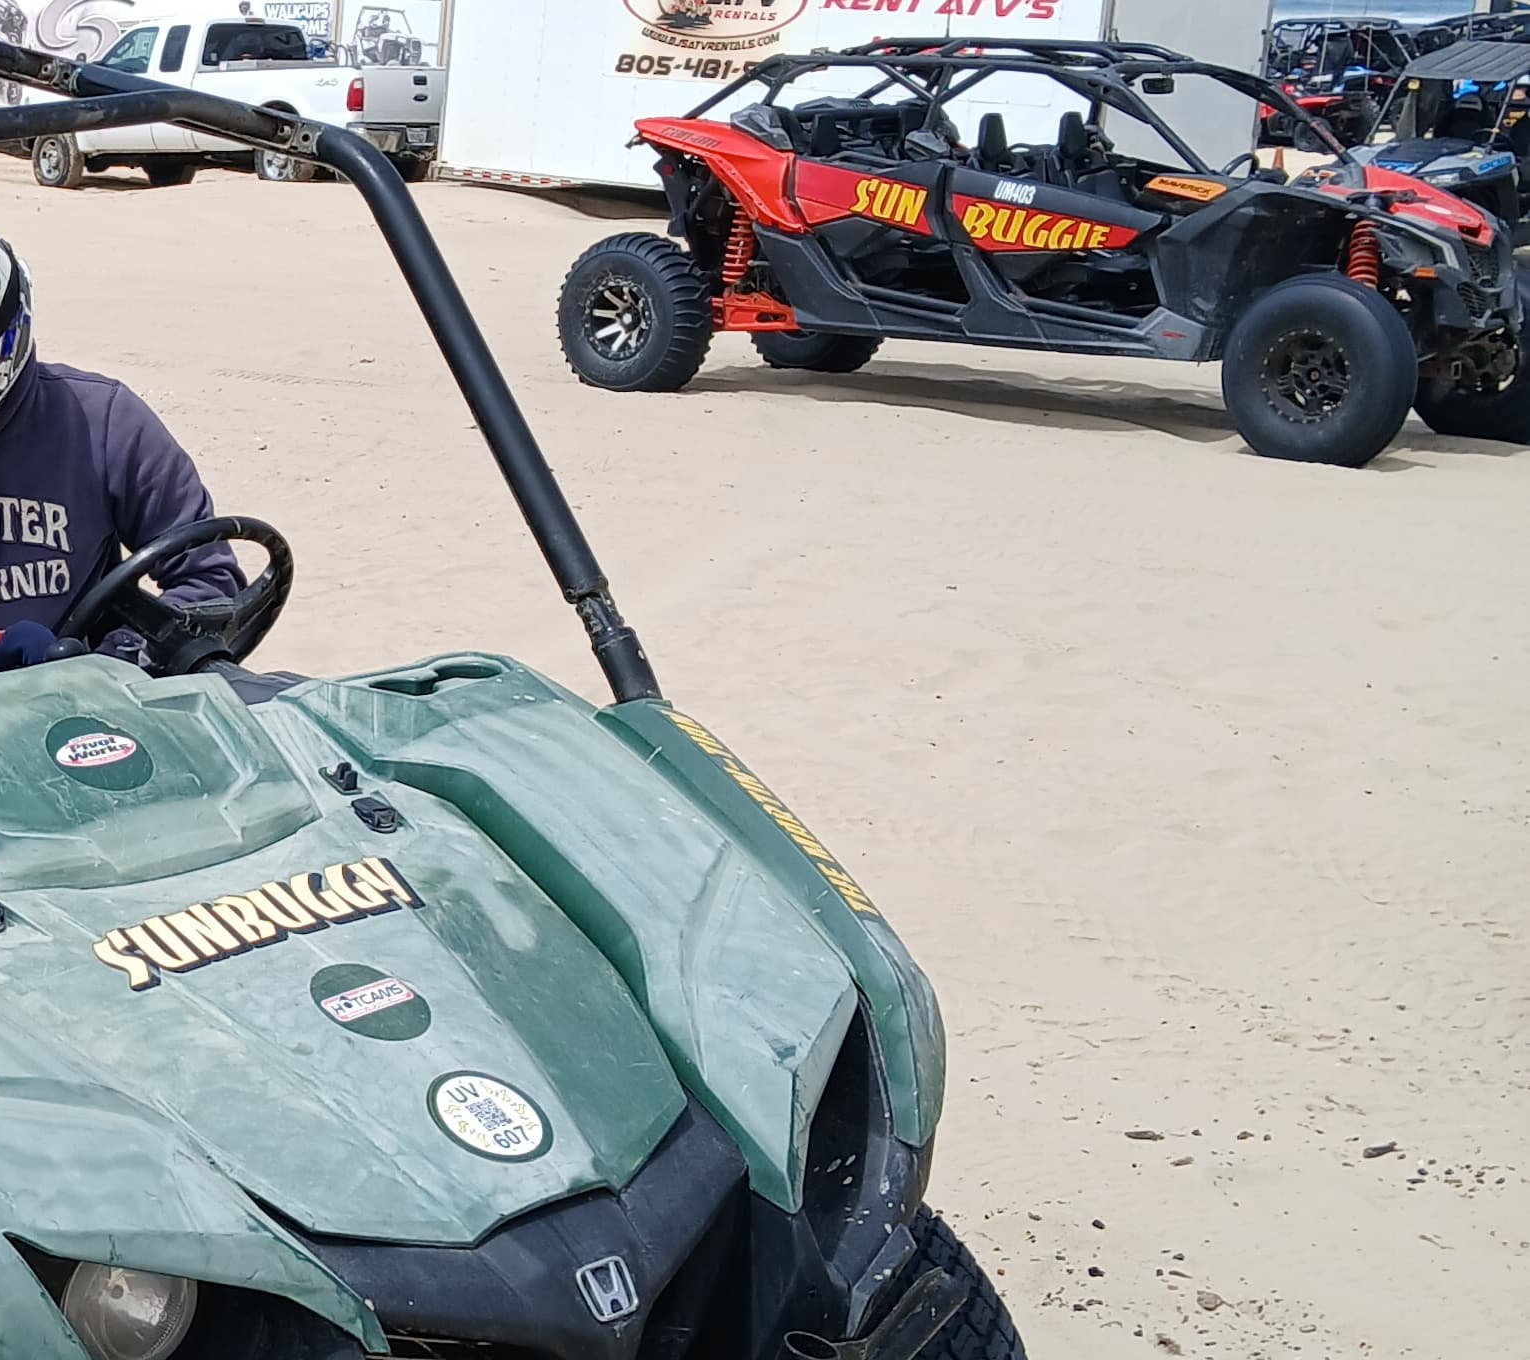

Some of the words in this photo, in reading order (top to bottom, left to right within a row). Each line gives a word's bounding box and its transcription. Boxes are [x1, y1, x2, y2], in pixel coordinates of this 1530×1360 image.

[713, 11, 777, 22] RENTALS
[848, 178, 928, 226] SUN
[961, 202, 1112, 250] BUGGIE
[92, 857, 425, 991] SUNBUGGY
[445, 1082, 480, 1103] UV
[492, 1125, 530, 1149] 607
